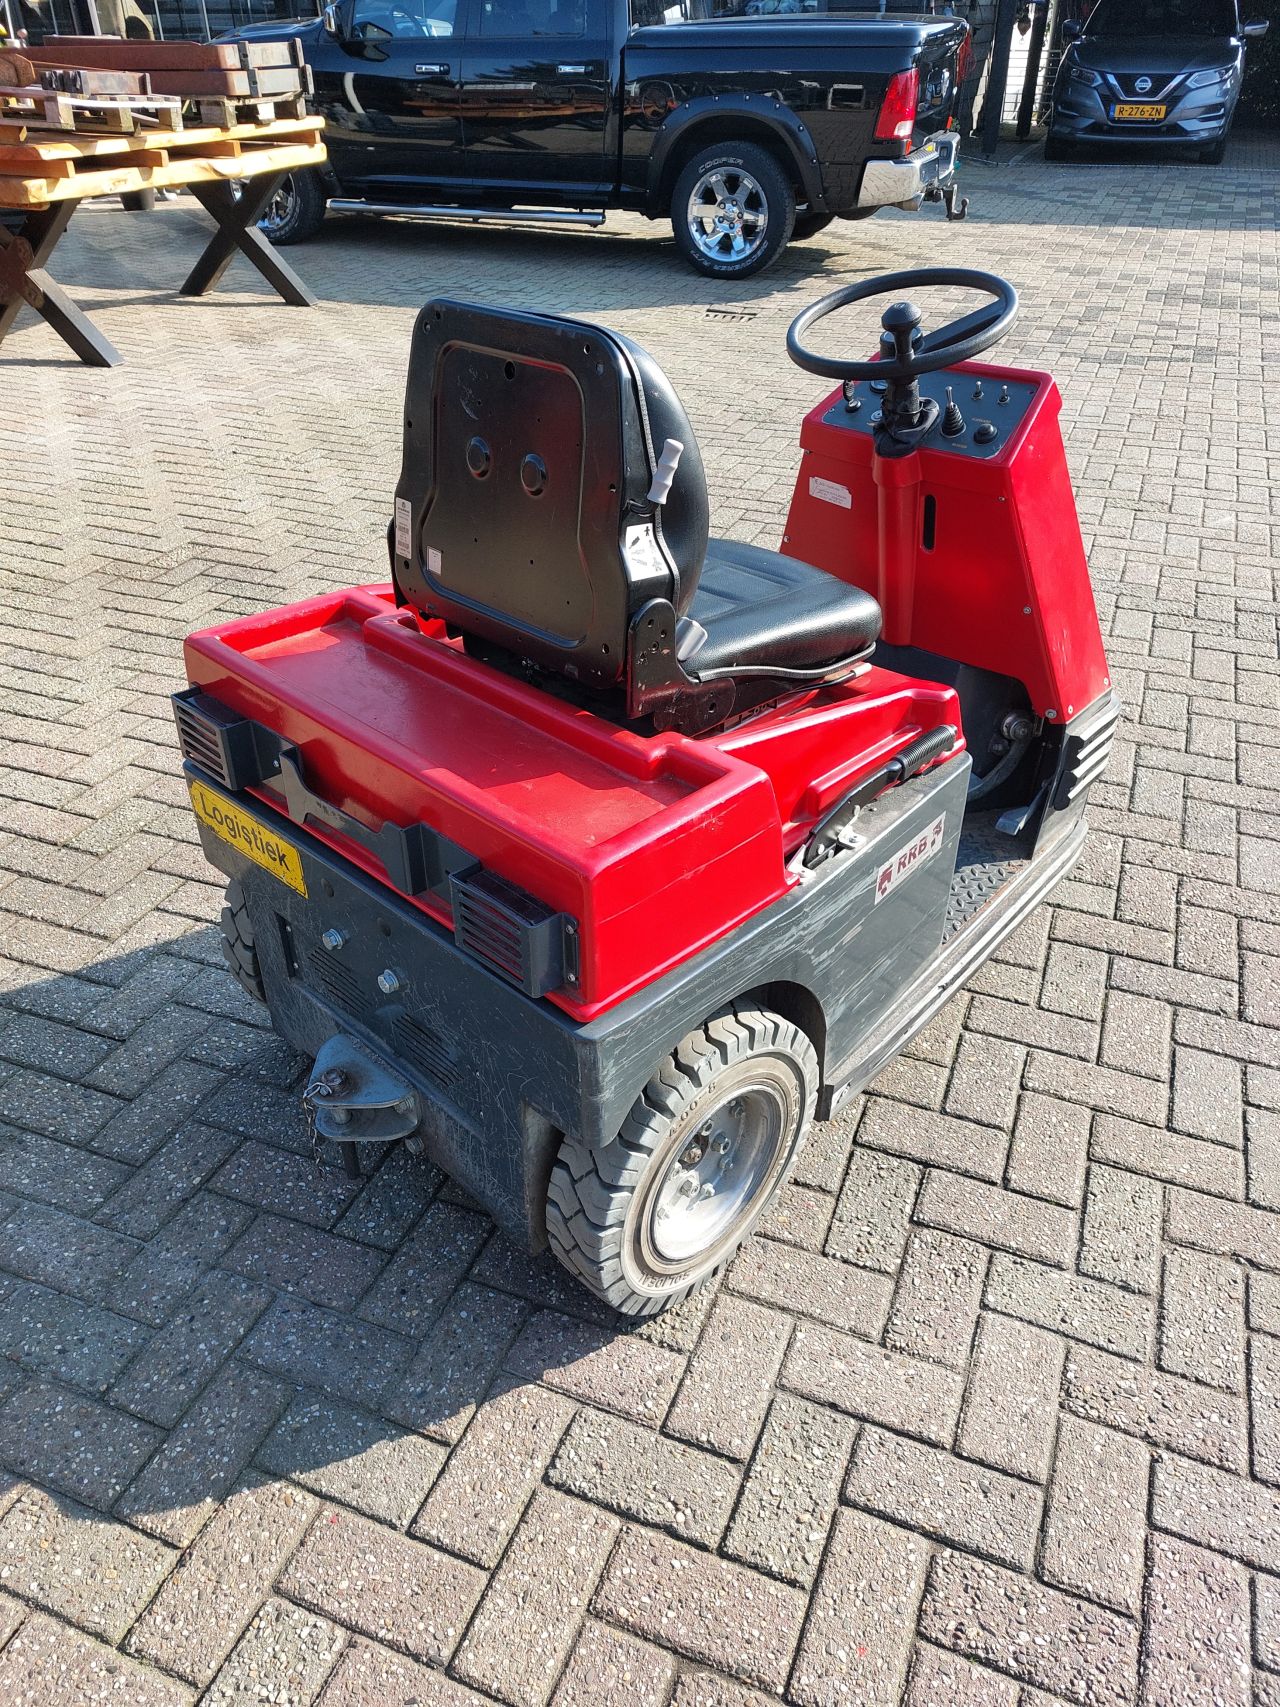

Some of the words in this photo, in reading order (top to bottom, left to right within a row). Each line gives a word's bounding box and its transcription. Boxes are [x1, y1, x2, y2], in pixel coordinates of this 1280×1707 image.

[1118, 106, 1162, 117] R-276-ZN
[698, 157, 744, 173] COOPER
[199, 791, 291, 873] Logistiek
[897, 835, 928, 875] RRB
